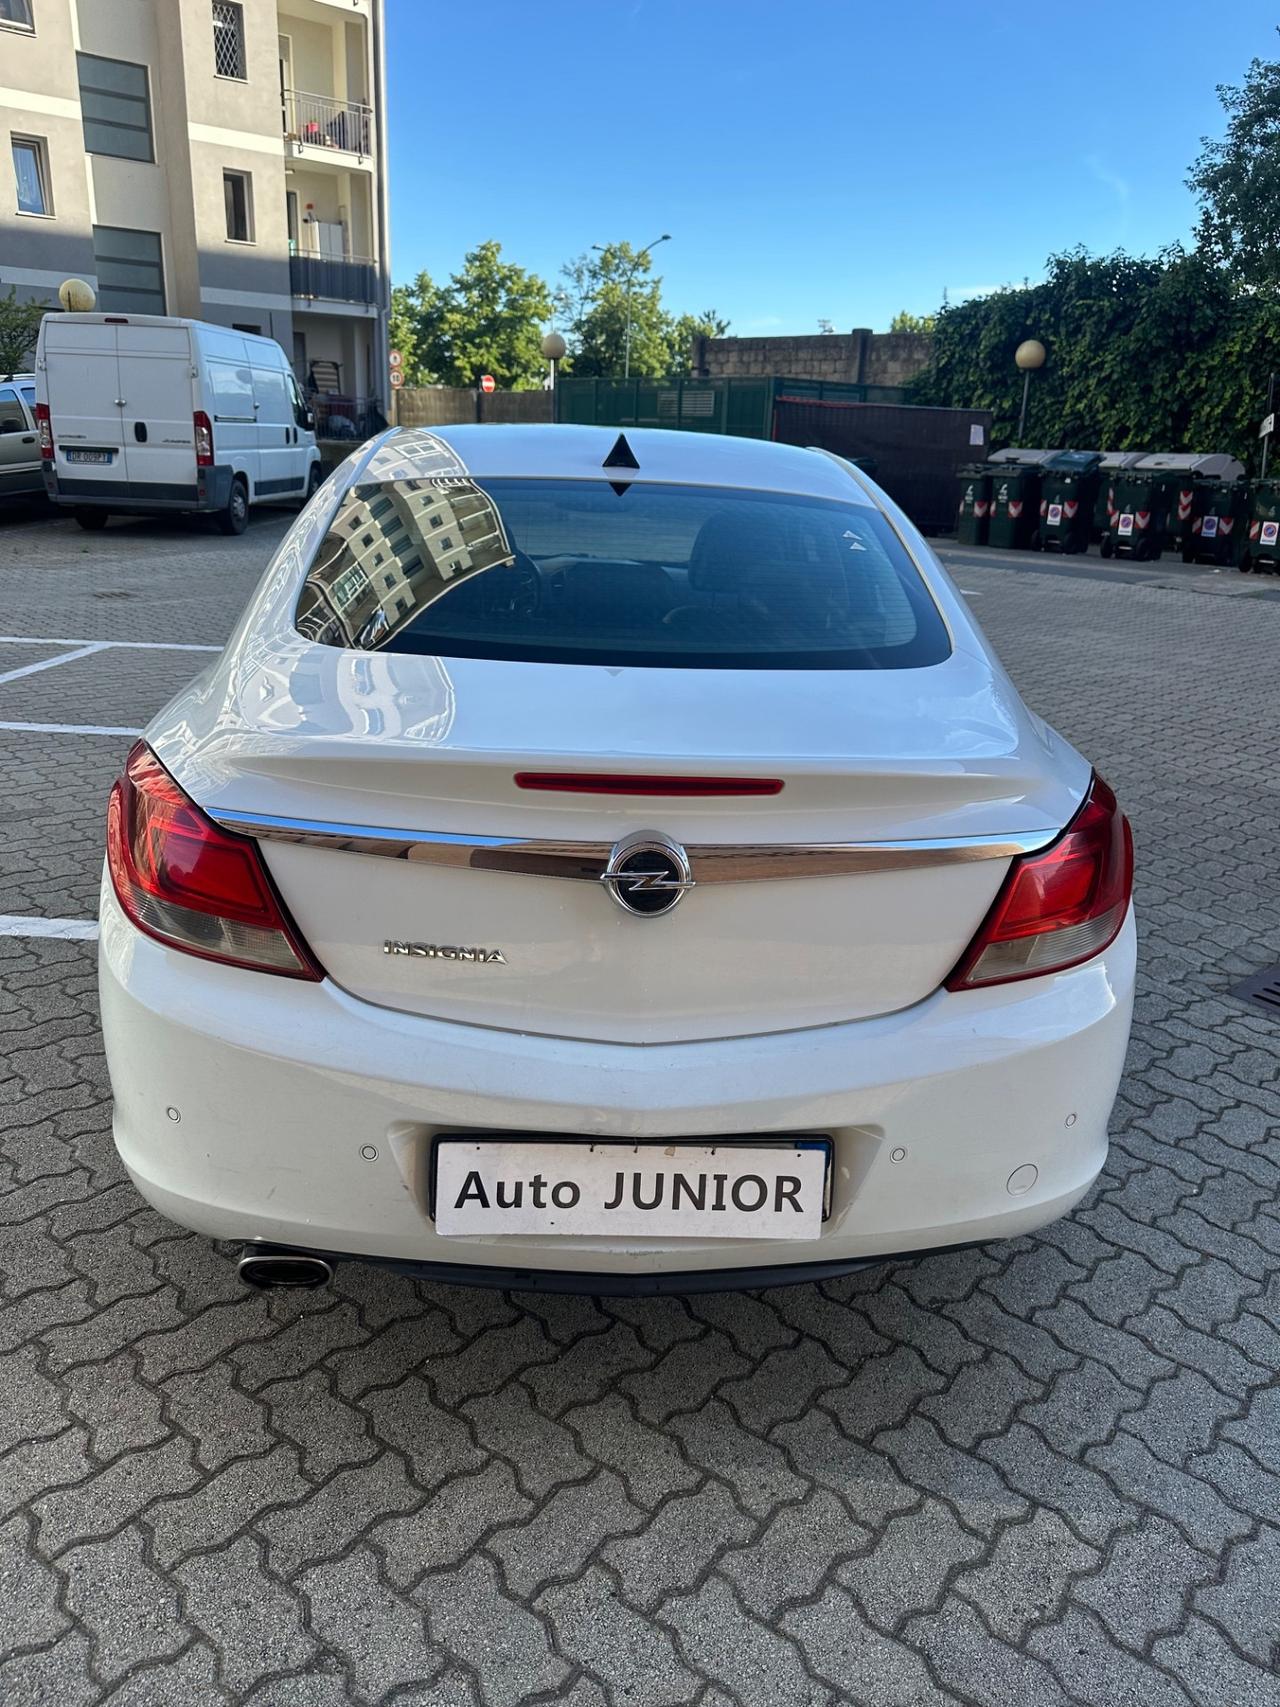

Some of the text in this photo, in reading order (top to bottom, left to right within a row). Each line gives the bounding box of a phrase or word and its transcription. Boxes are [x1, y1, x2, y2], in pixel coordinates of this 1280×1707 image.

[384, 940, 507, 964] INSIGNIA
[453, 1171, 804, 1213] Auto JUNIOR
